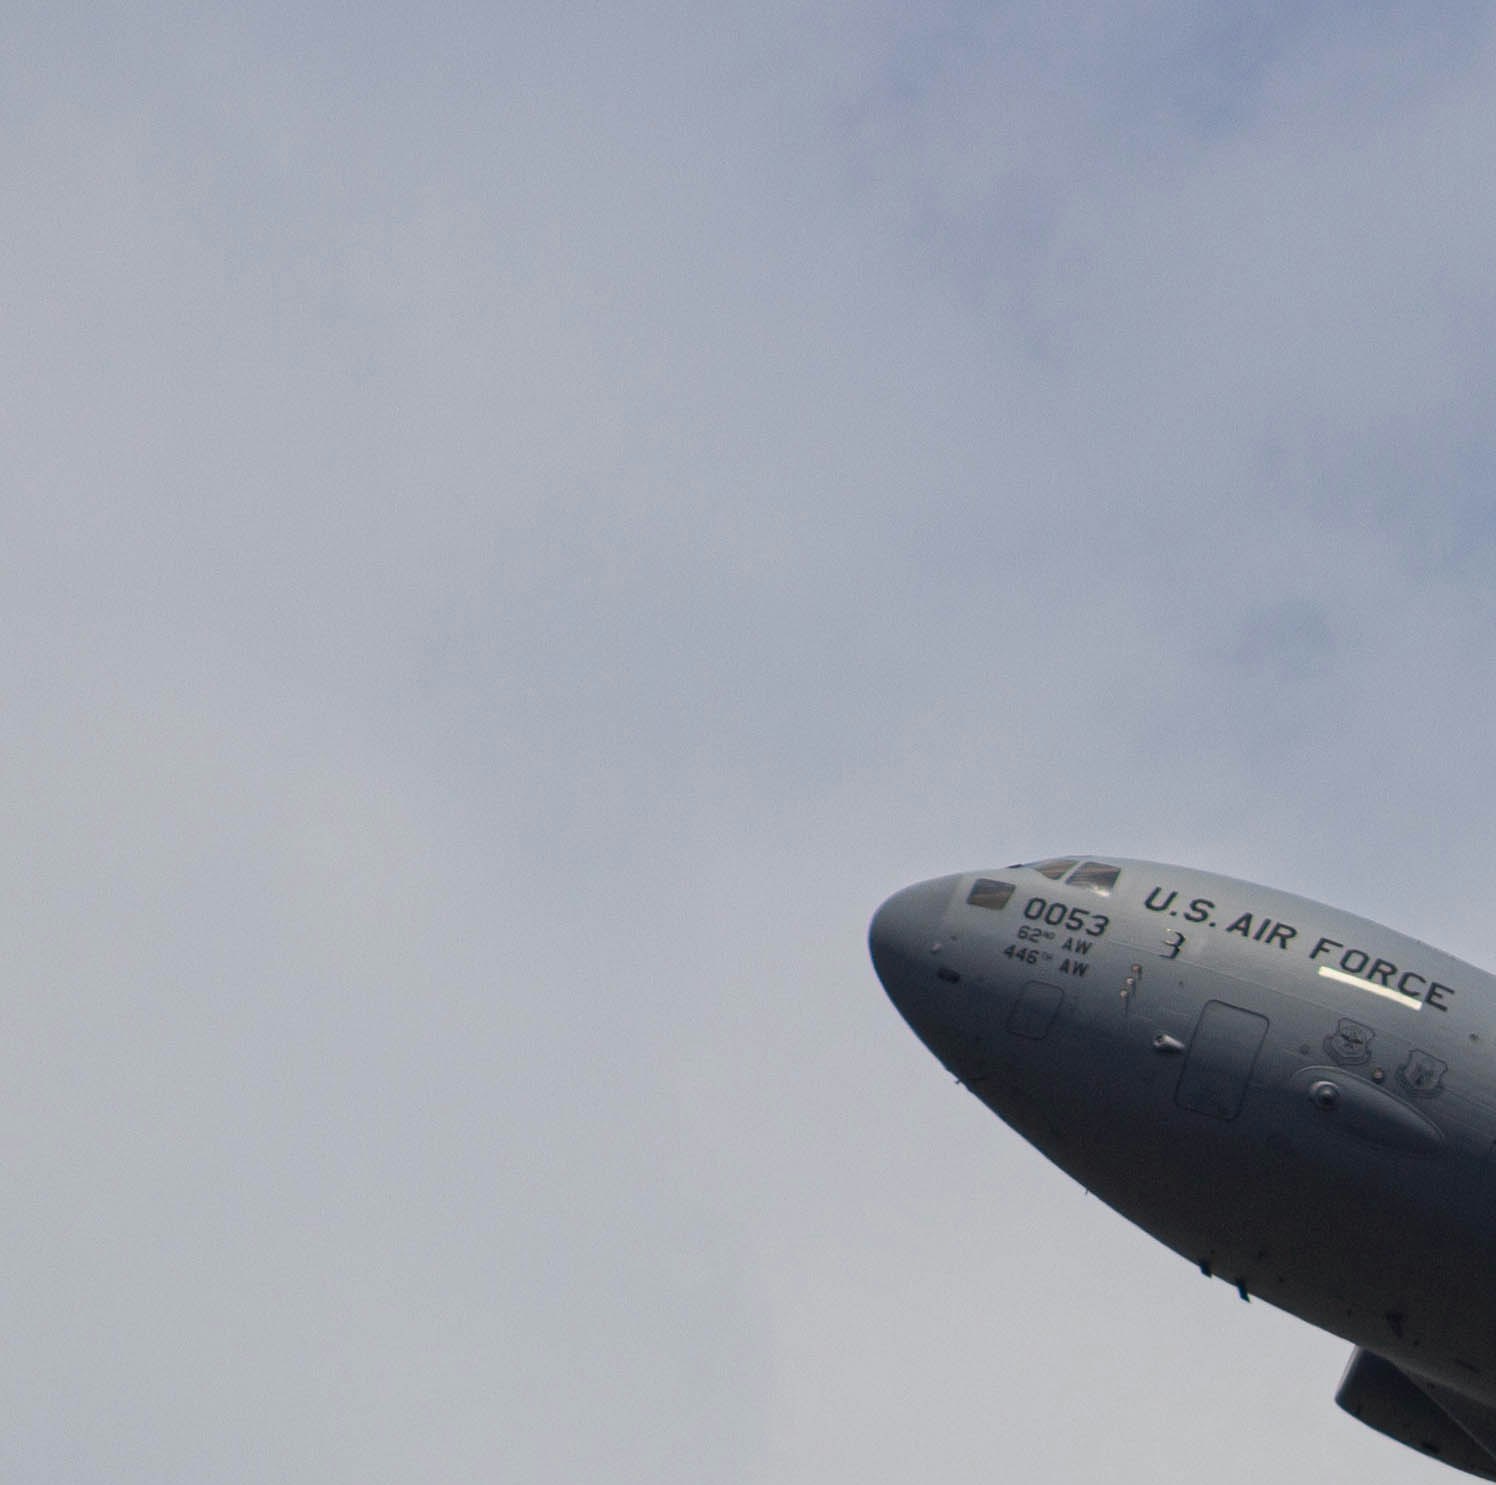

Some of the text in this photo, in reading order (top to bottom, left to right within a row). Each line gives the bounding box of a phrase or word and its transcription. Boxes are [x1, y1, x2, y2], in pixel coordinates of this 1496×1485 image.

[1024, 897, 1110, 937] 0053
[1061, 936, 1093, 956] AW
[1144, 886, 1456, 1013] U.S. AIR FORCE
[1059, 957, 1090, 977] AW
